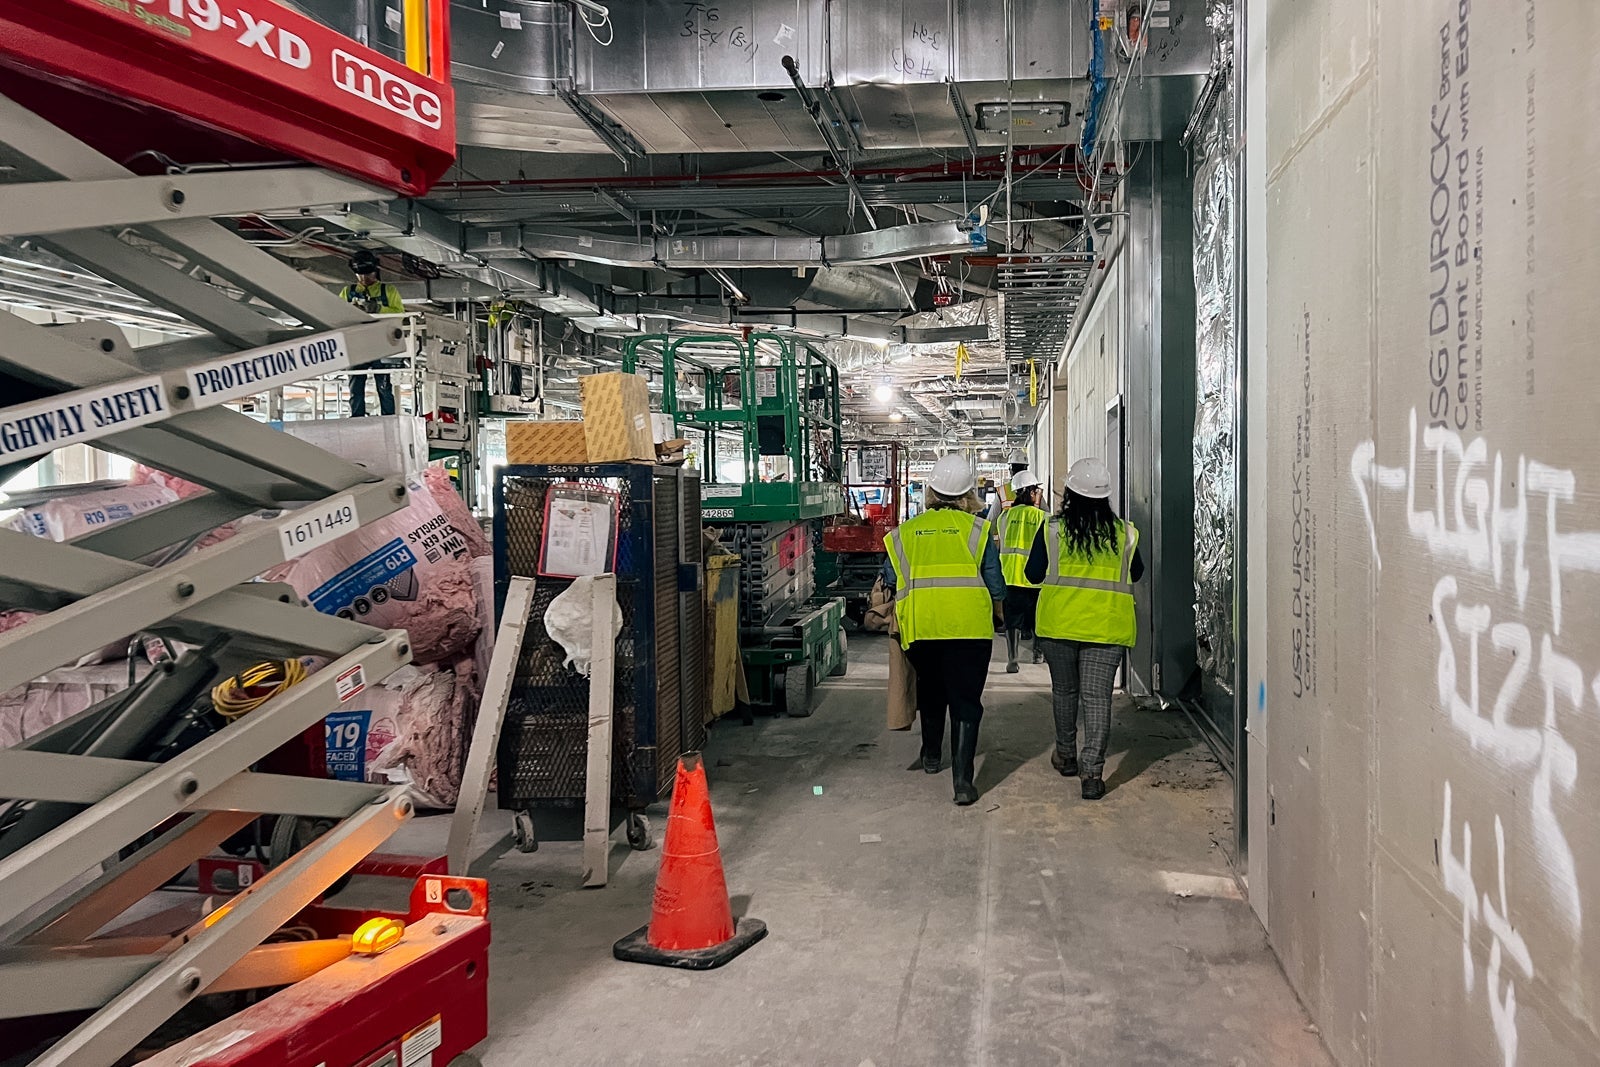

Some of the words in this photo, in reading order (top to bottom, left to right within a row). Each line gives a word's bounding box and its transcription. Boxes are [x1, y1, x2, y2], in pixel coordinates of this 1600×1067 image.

[137, 0, 312, 70] 19-XD
[1439, 20, 1451, 101] Brand
[335, 54, 440, 123] mec
[1458, 81, 1470, 142] with
[1455, 149, 1469, 267] Board
[194, 349, 298, 397] PROTECTION
[299, 337, 345, 368] CORP.
[440, 345, 456, 356] JLG
[1454, 277, 1469, 431] Cement
[0, 403, 86, 455] GHWAY
[91, 384, 164, 436] SAFETY
[84, 510, 106, 525] R19
[284, 506, 352, 546] 1611449
[421, 534, 439, 550] GEN
[1303, 508, 1311, 584] Board
[385, 548, 412, 571] R19
[1292, 627, 1303, 699] USG
[1303, 590, 1311, 692] Cement
[326, 752, 356, 761] FACED
